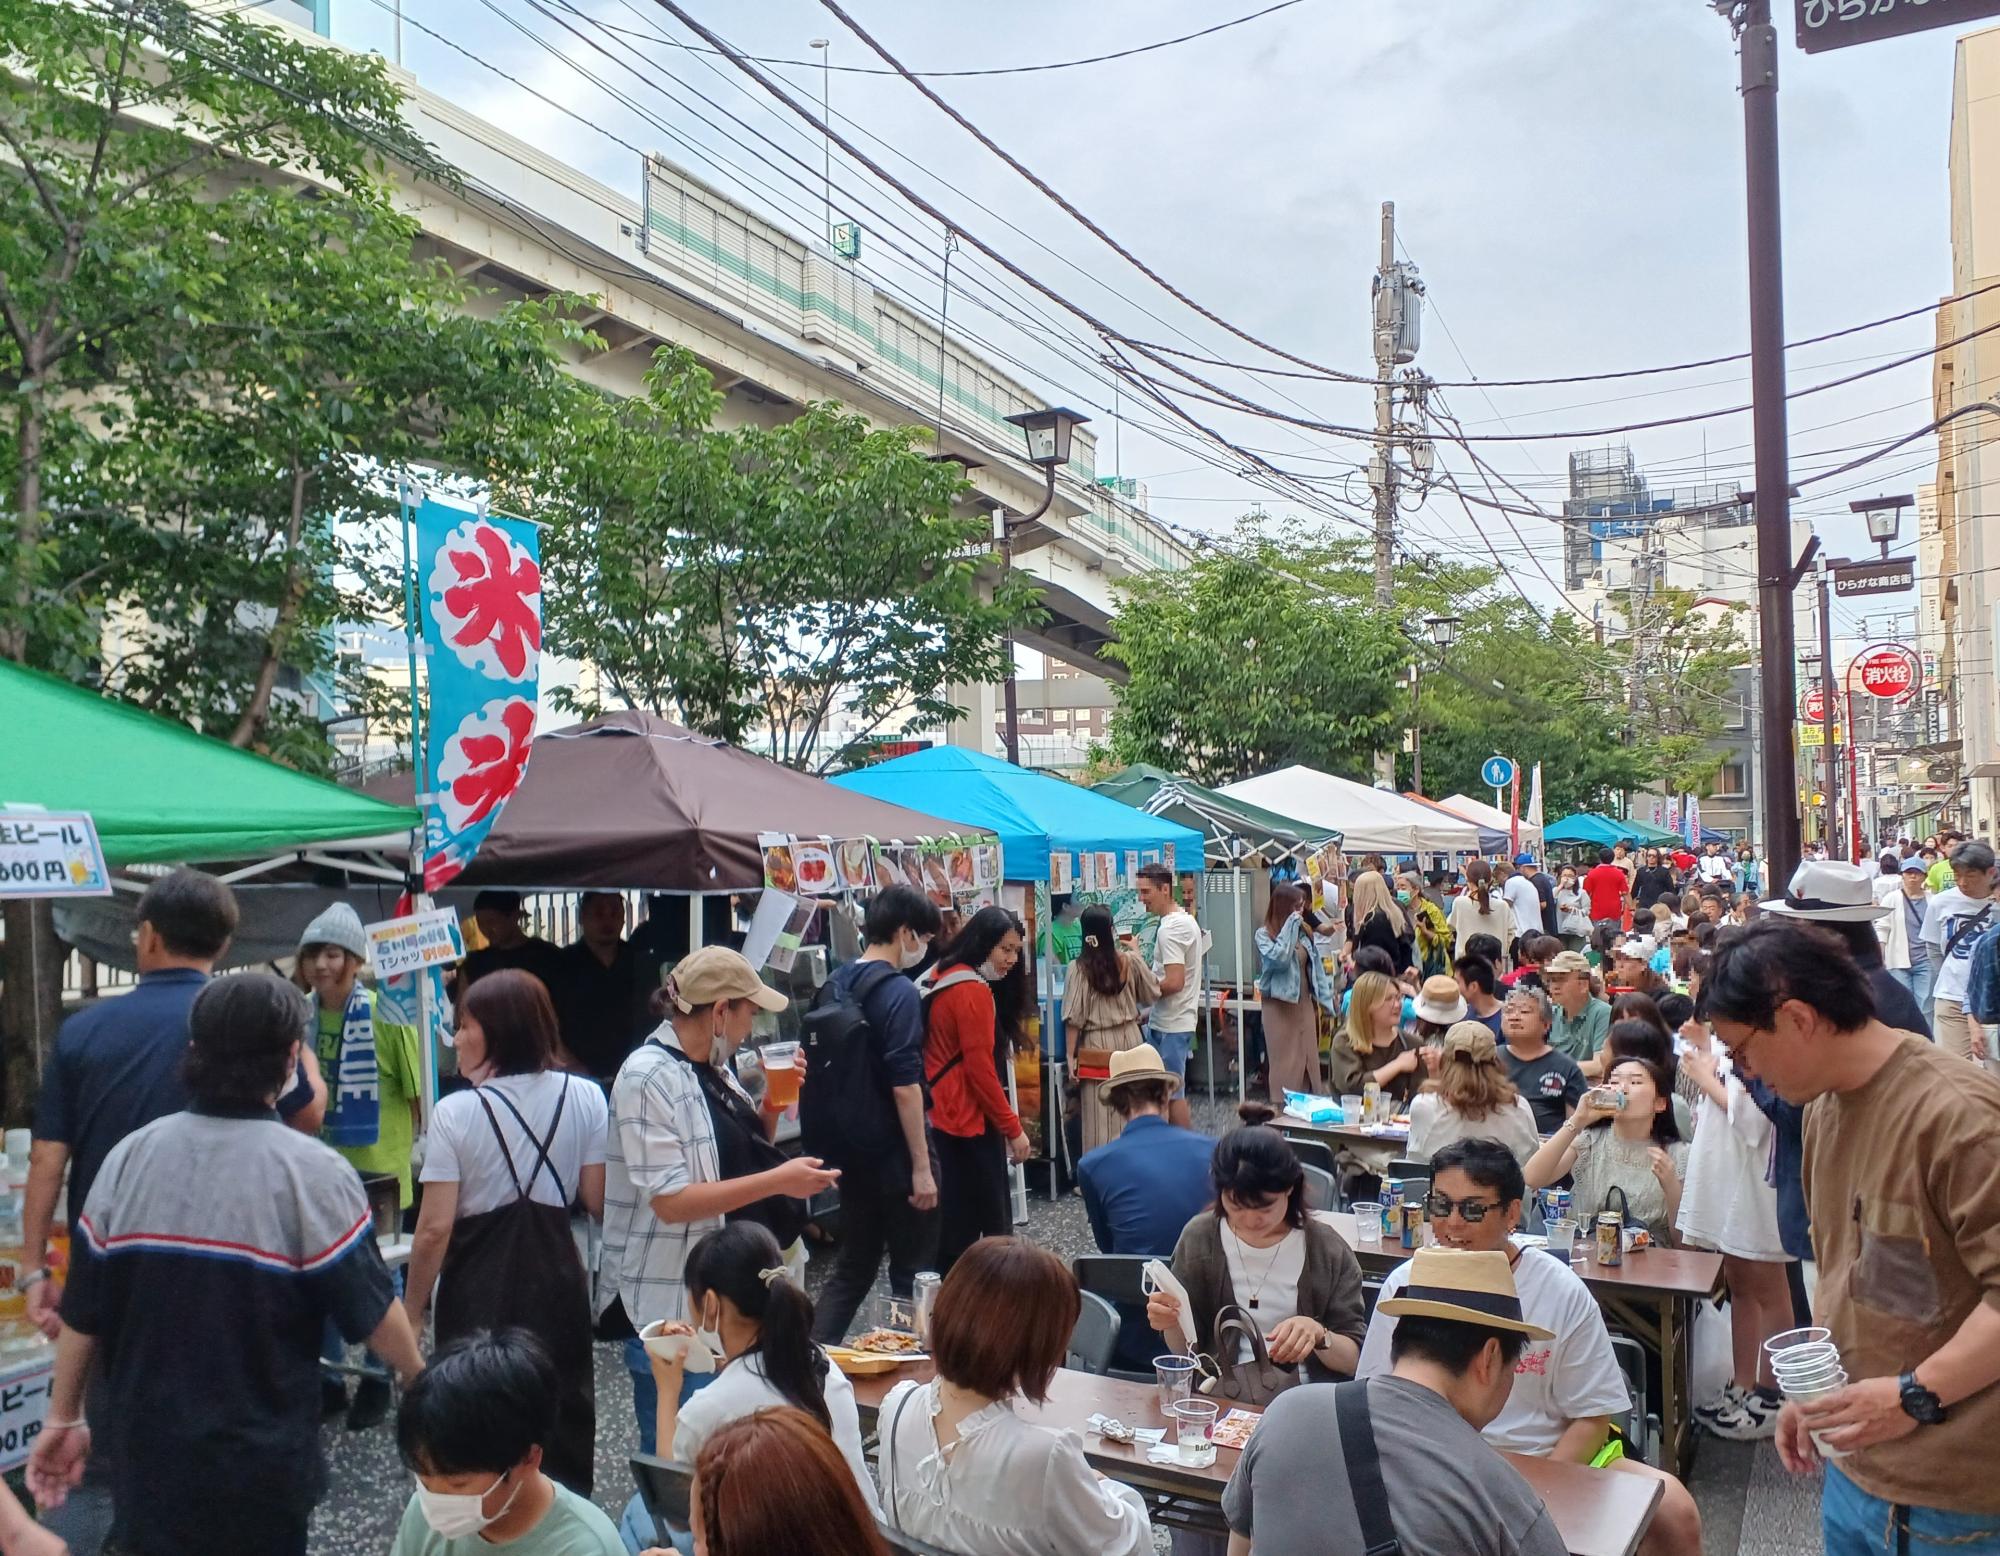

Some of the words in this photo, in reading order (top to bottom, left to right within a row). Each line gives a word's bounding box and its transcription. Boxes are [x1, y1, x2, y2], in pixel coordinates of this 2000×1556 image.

[1837, 573, 1912, 591] ひらがな商店街
[444, 525, 540, 678] 氷
[1865, 665, 1908, 685] 消火栓
[1928, 692, 1938, 744] MOTOWN
